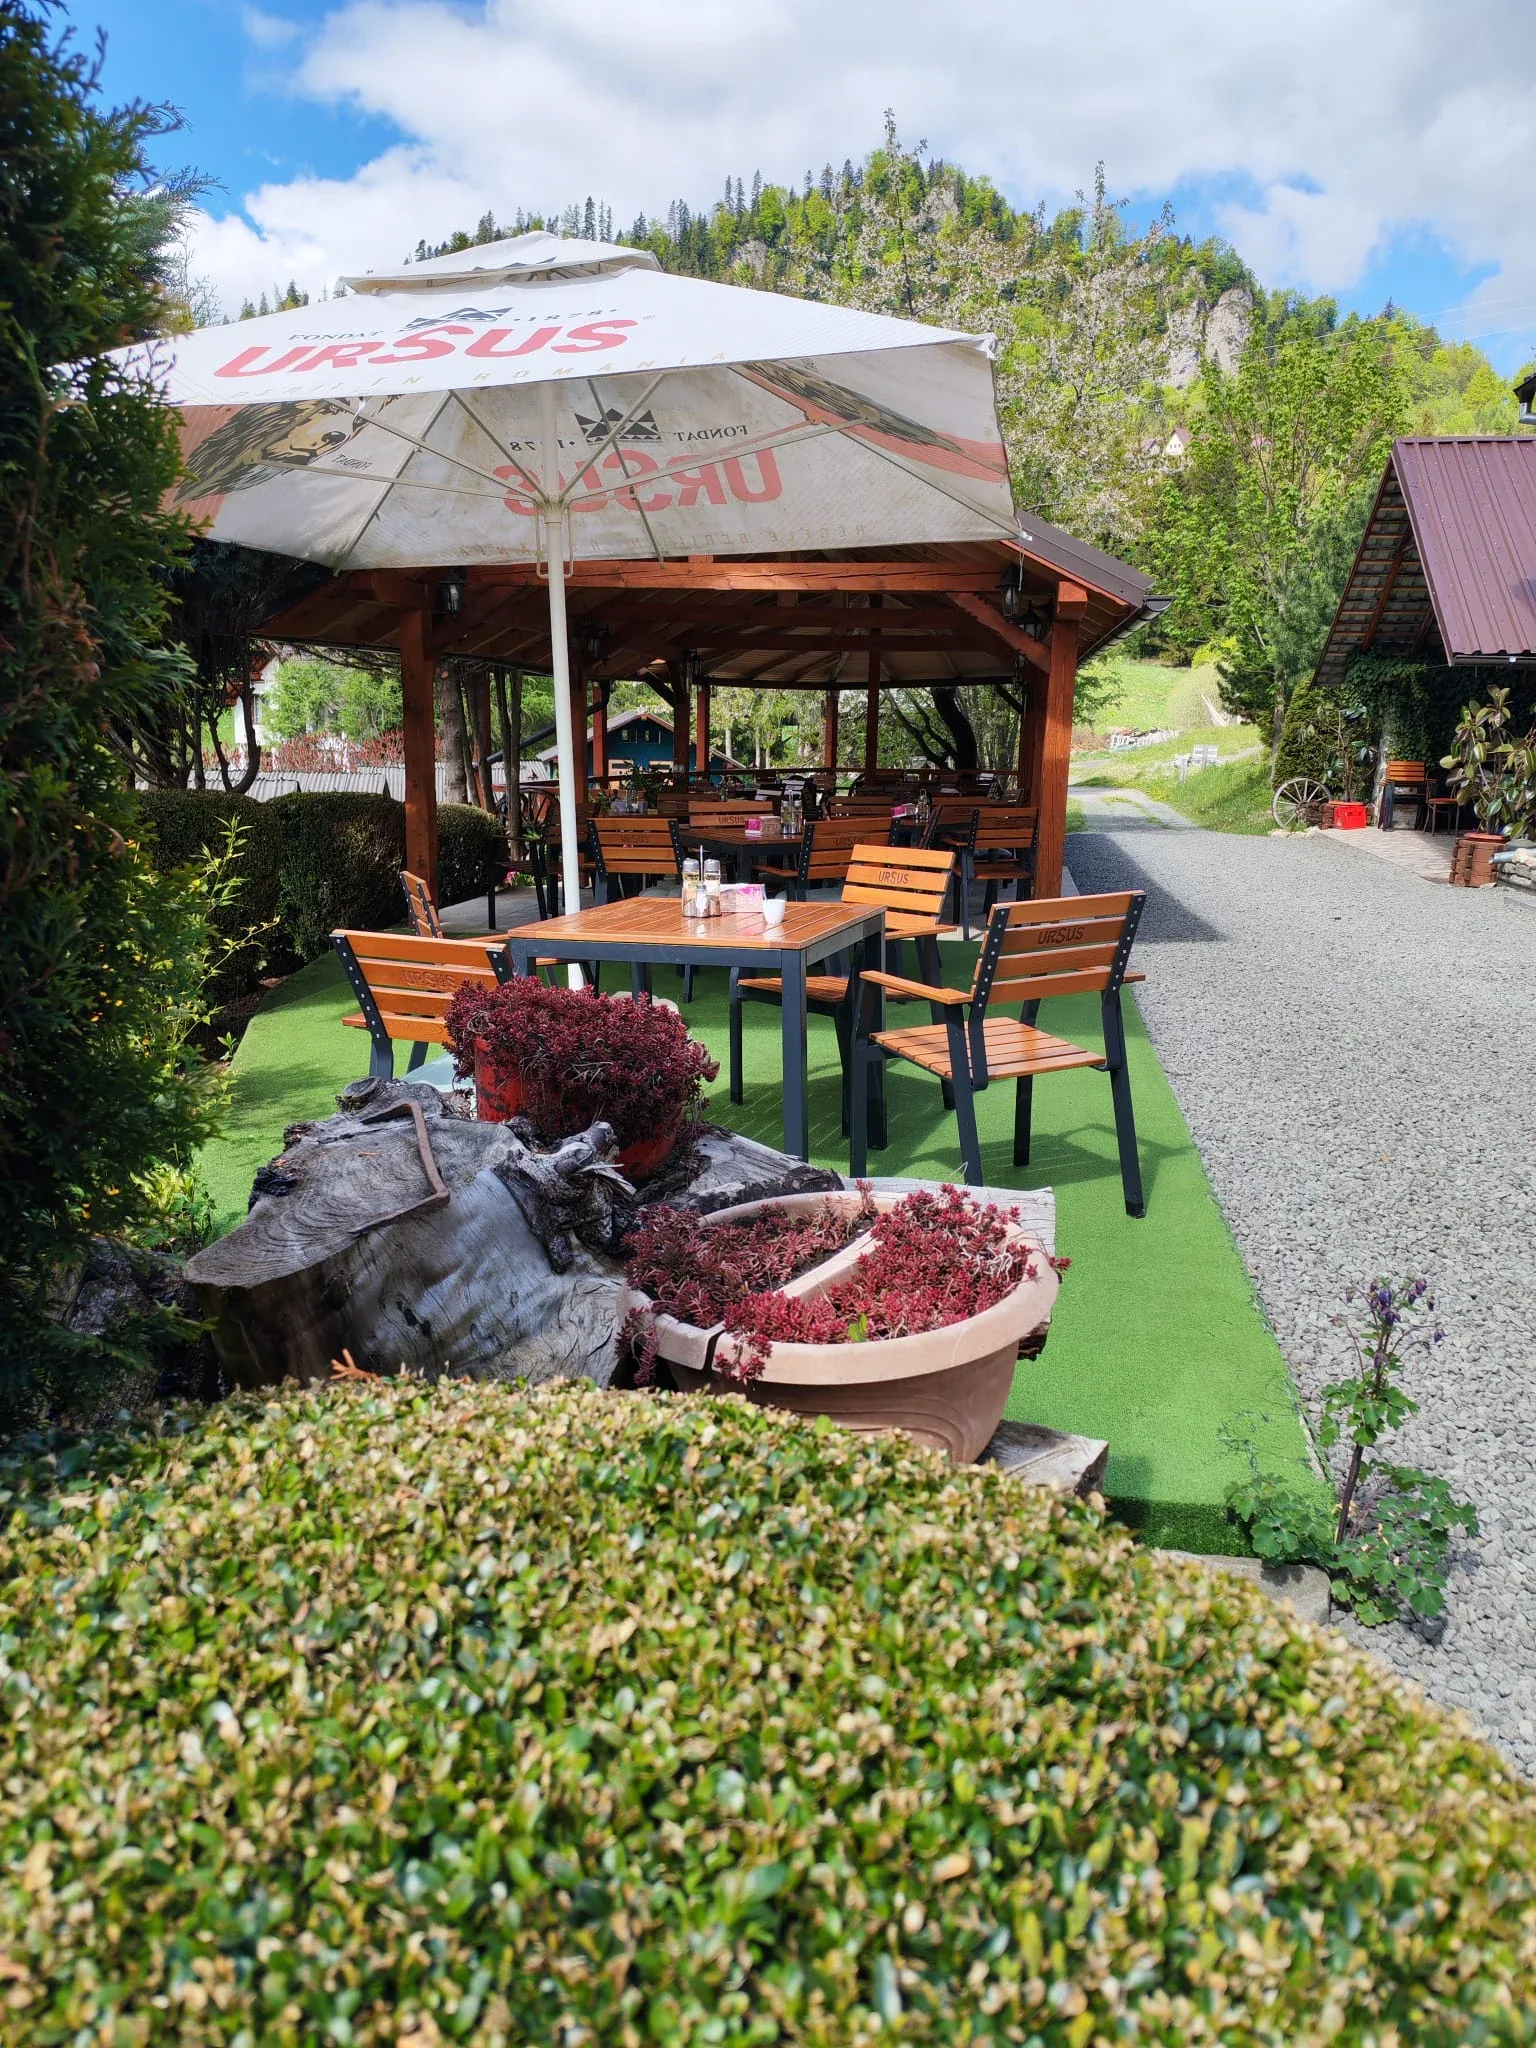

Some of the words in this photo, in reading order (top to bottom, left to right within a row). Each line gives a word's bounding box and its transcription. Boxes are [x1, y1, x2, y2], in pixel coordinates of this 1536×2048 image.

[288, 329, 385, 341] FONDAT
[213, 319, 639, 378] URSUS
[718, 815, 745, 826] URSUS
[878, 870, 911, 885] URSUS
[1037, 926, 1086, 946] URSUS
[401, 969, 459, 991] URSUS
